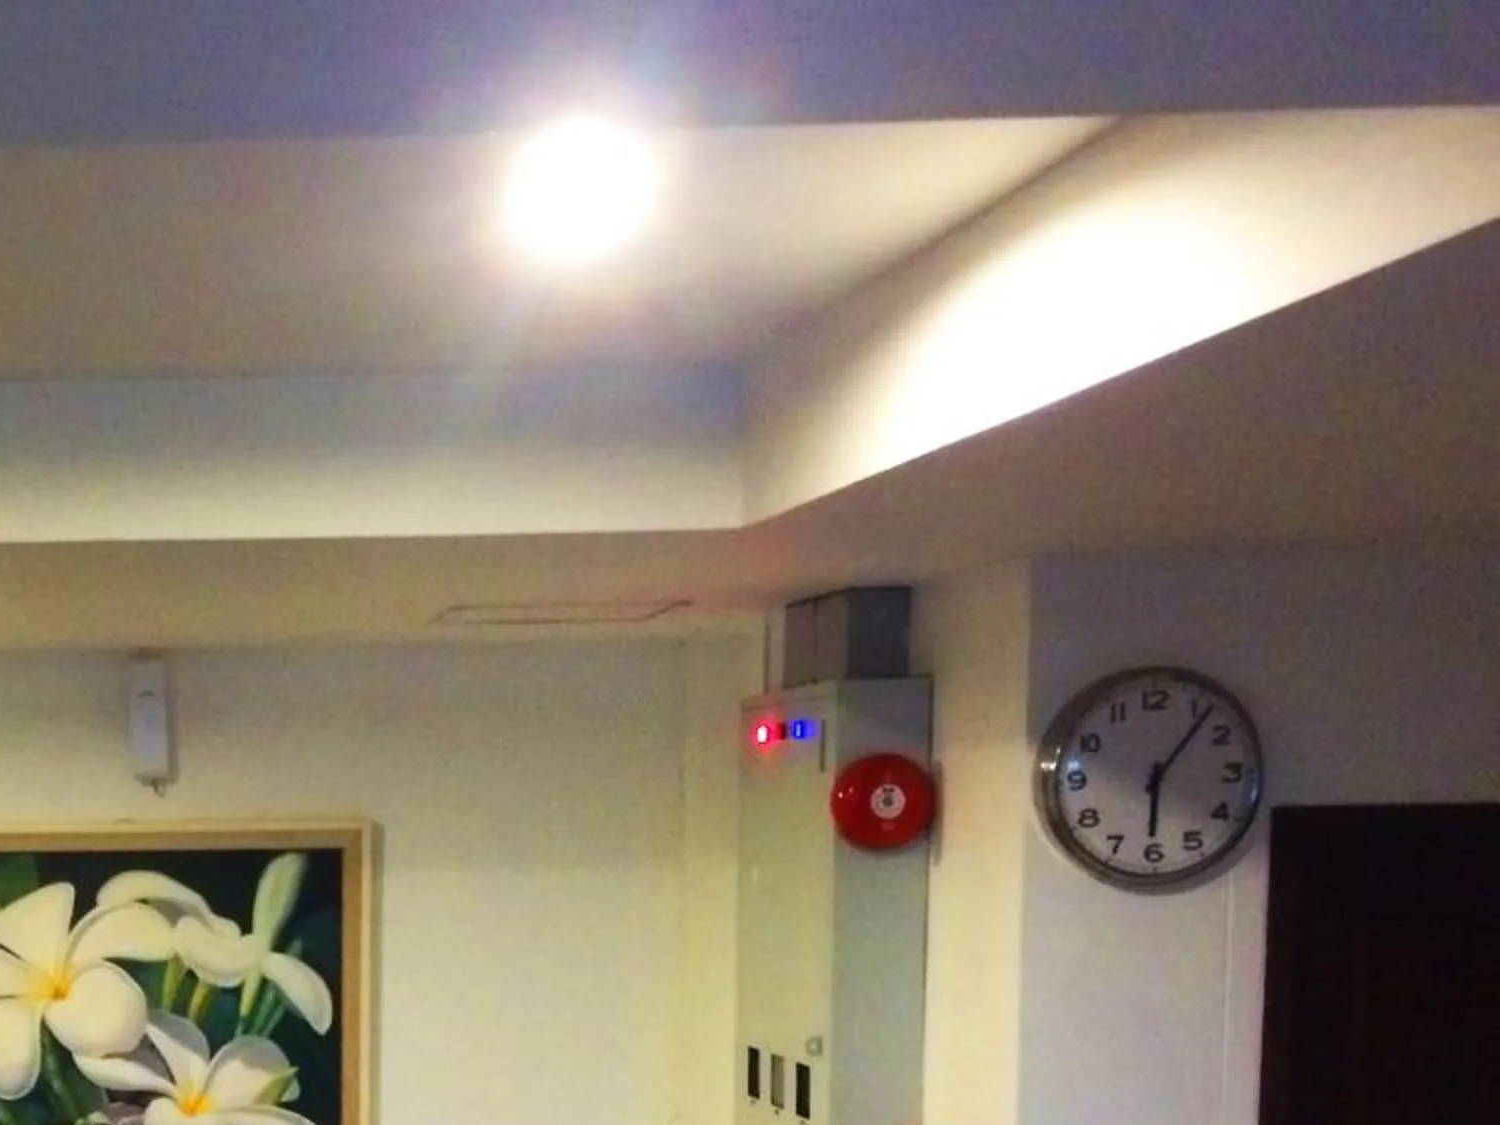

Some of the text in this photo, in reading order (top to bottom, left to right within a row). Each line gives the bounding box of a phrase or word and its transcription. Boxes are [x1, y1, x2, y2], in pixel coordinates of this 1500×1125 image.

[1141, 689, 1171, 712] 12
[1079, 732, 1101, 753] 10
[1211, 724, 1231, 746] 2
[1066, 770, 1088, 792] 9
[1221, 762, 1243, 784] 3
[1077, 807, 1100, 829] 8
[1209, 801, 1230, 821] 4
[1106, 834, 1124, 855] 7
[1182, 830, 1203, 852] 5
[1143, 843, 1165, 864] 6
